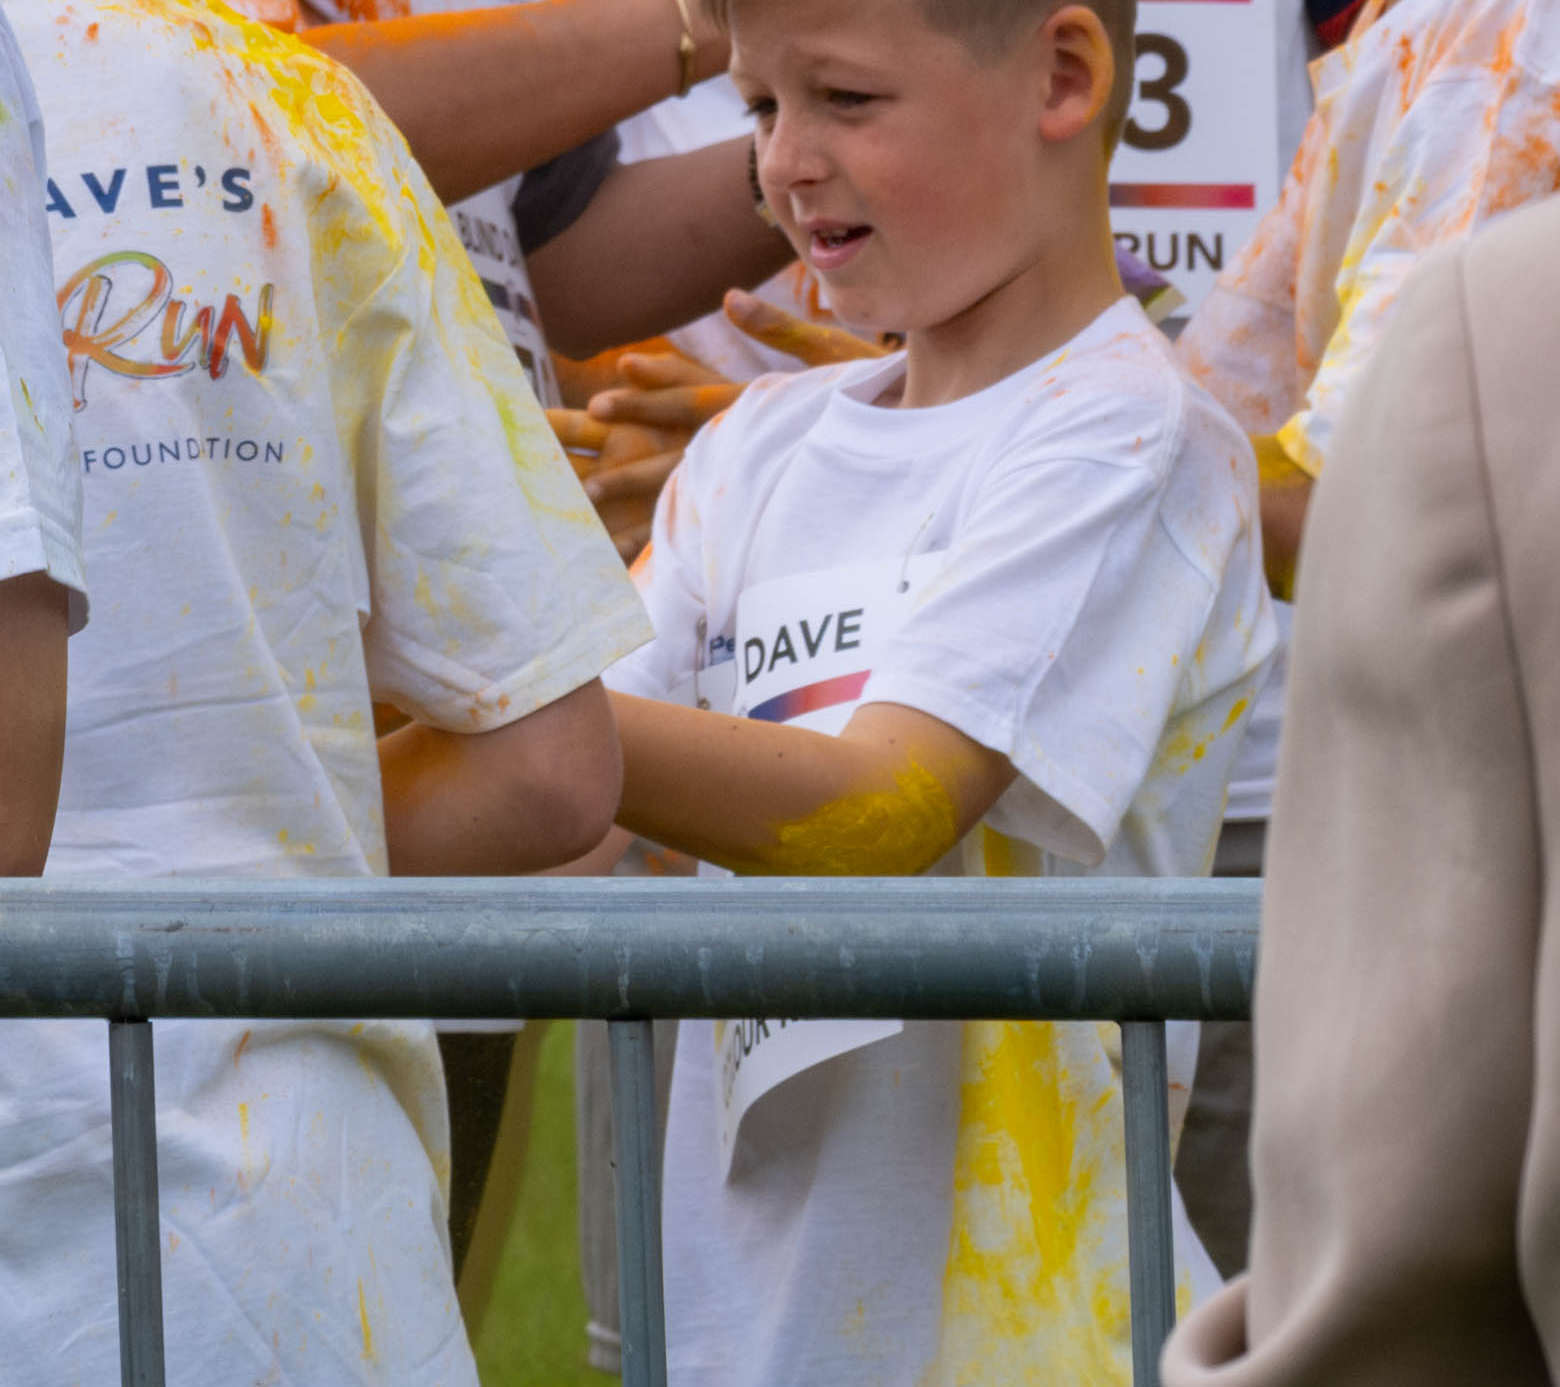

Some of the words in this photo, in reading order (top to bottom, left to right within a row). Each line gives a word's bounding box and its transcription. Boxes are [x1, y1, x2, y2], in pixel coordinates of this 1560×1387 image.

[1121, 32, 1193, 153] 3
[83, 437, 284, 474] FOUNDTION
[744, 607, 864, 685] DAVE
